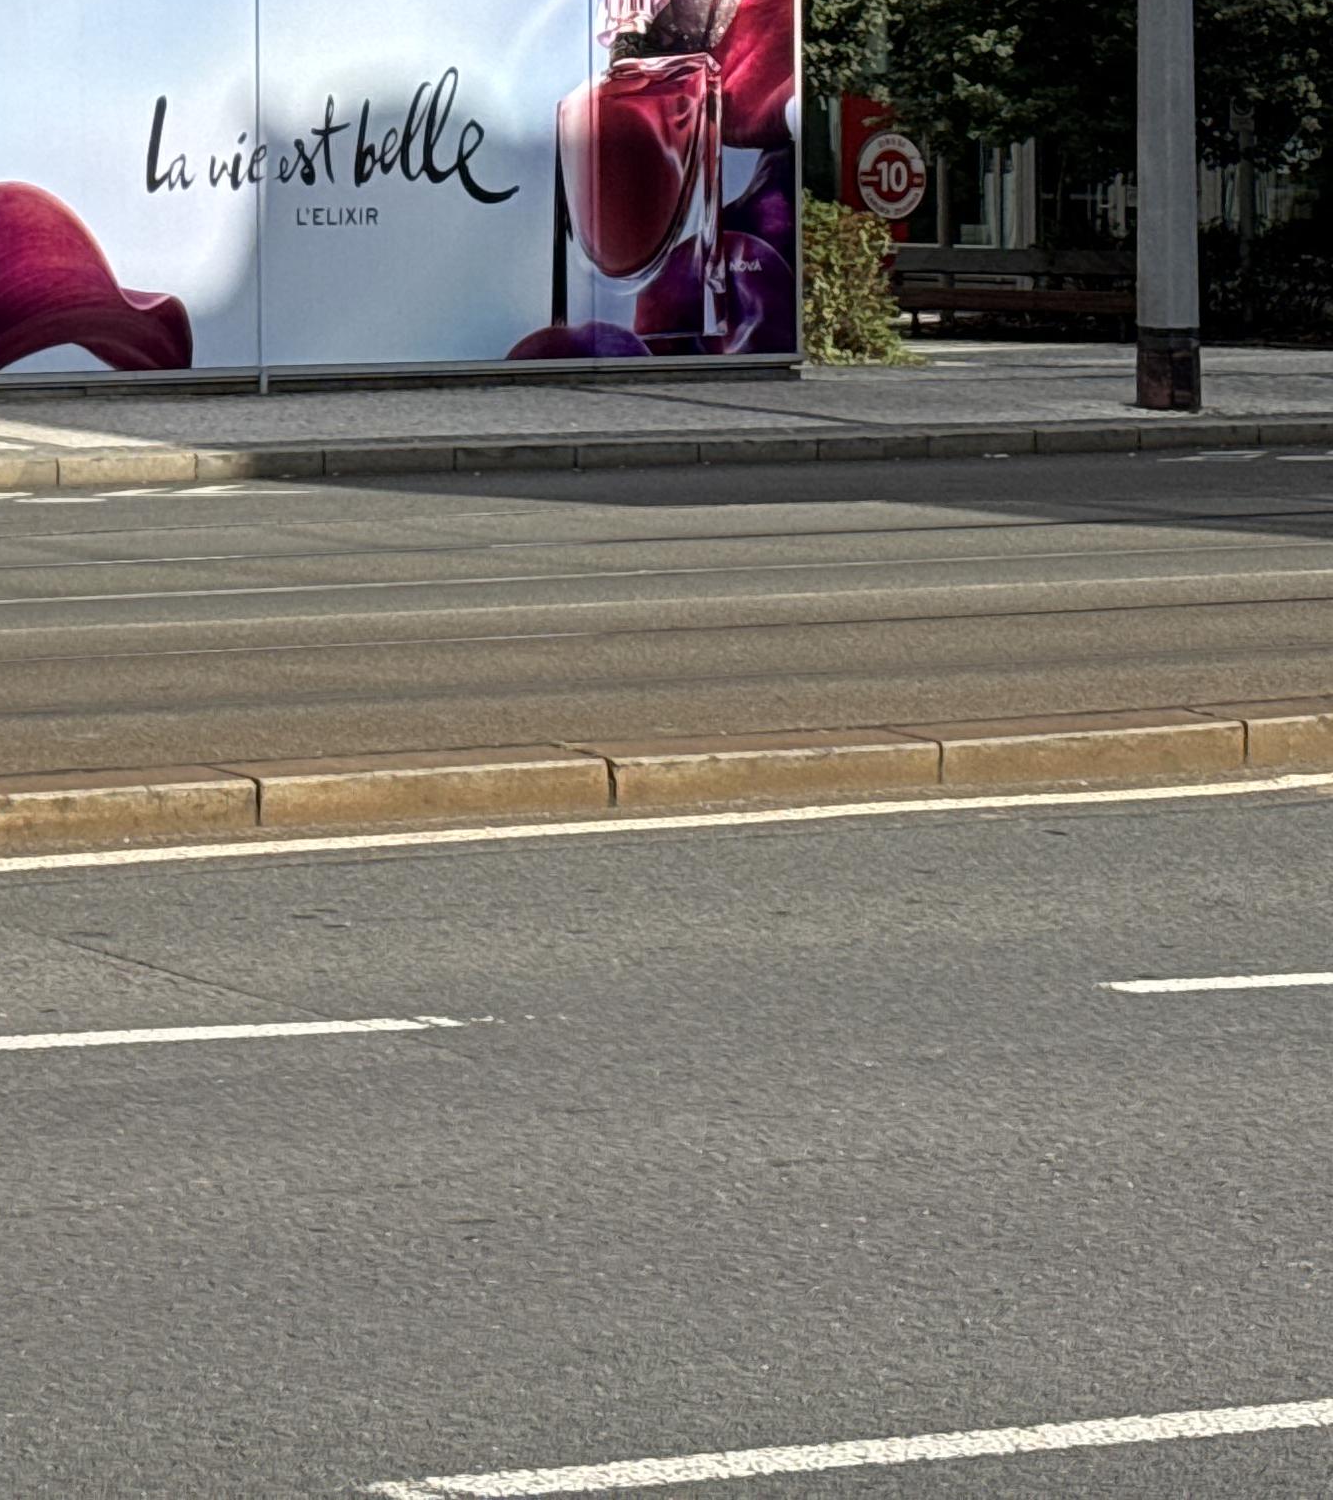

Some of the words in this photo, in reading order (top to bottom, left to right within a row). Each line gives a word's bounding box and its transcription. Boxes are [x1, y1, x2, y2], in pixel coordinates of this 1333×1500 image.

[146, 95, 194, 193] La
[209, 132, 268, 191] vie
[277, 95, 351, 185] est
[354, 66, 520, 204] belle
[876, 161, 908, 193] 10
[297, 207, 378, 226] L'ELIXIR
